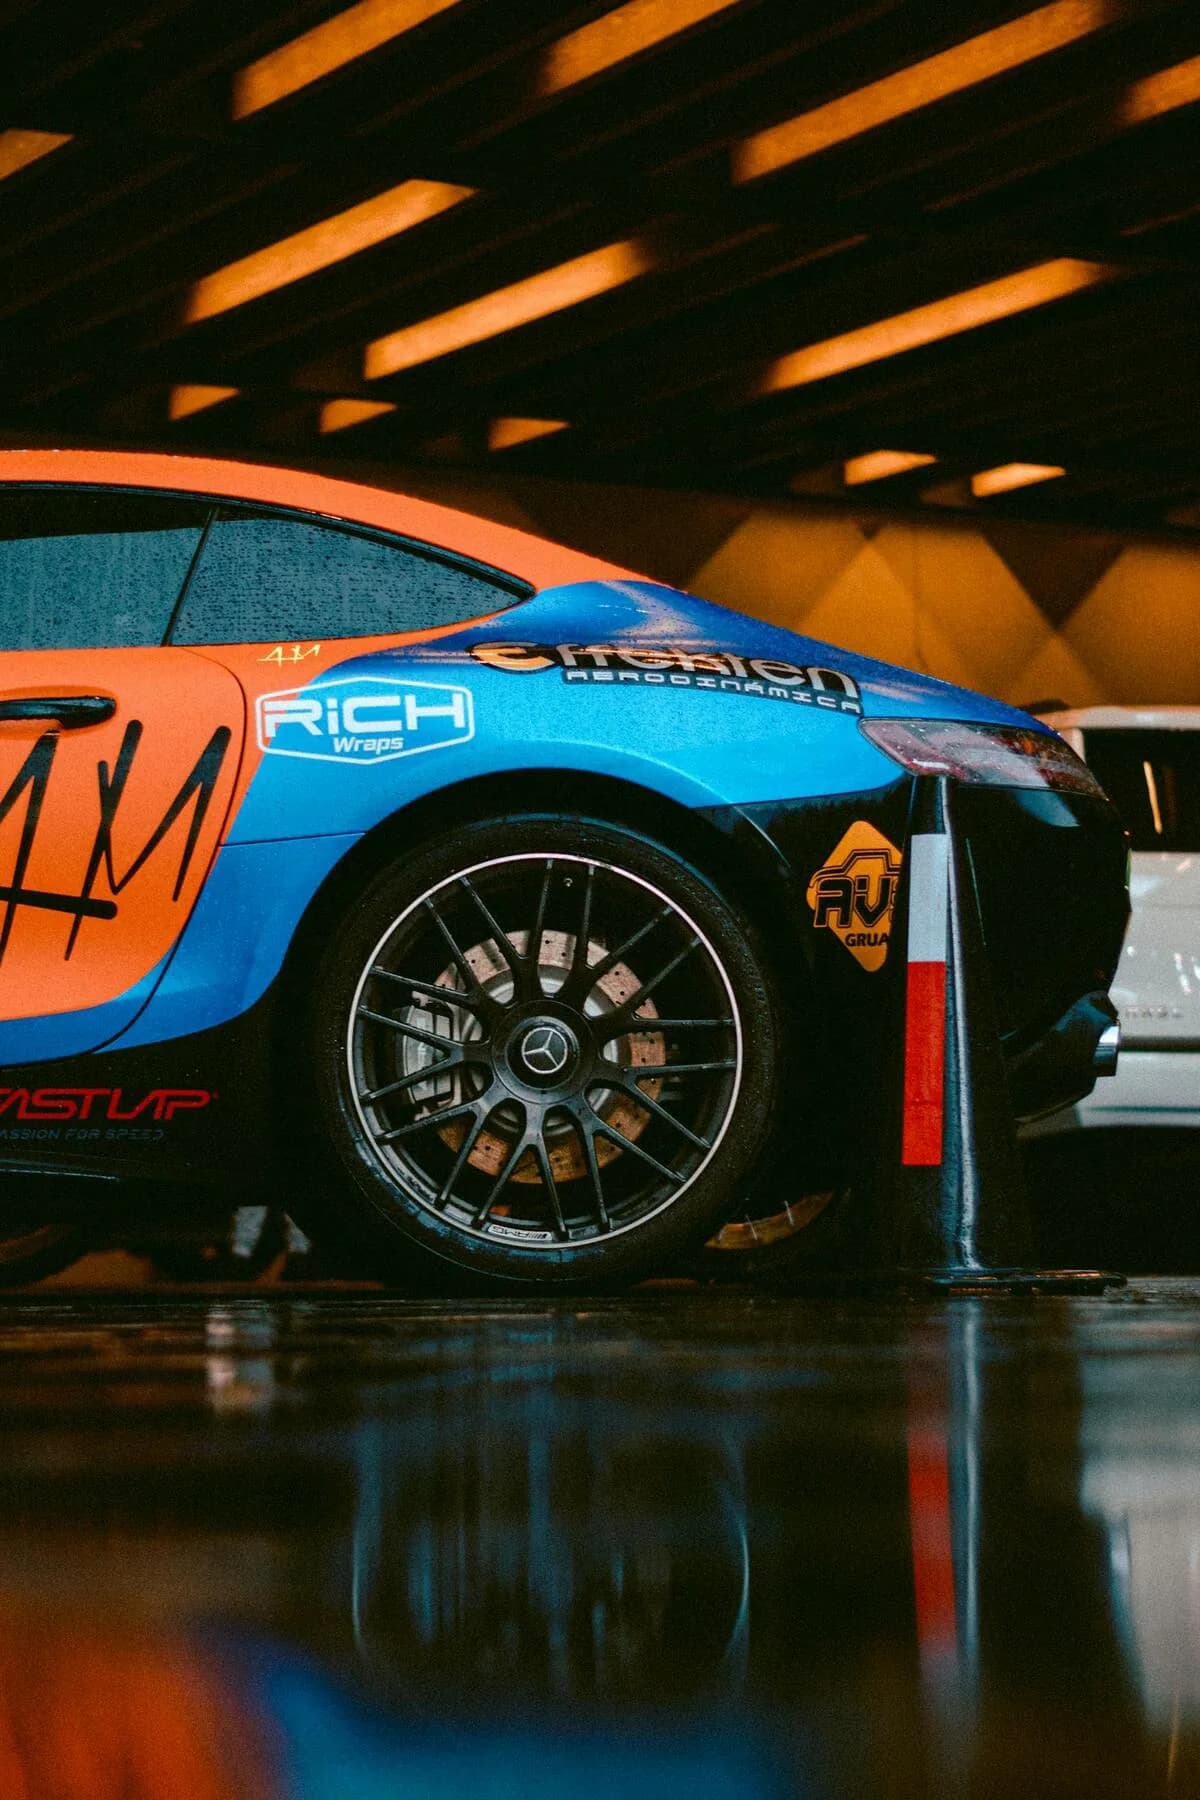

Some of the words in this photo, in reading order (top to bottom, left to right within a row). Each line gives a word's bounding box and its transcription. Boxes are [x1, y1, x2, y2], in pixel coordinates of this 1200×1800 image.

[332, 736, 404, 755] Wraps
[65, 1128, 101, 1141] FOR
[105, 1128, 165, 1142] SPEED
